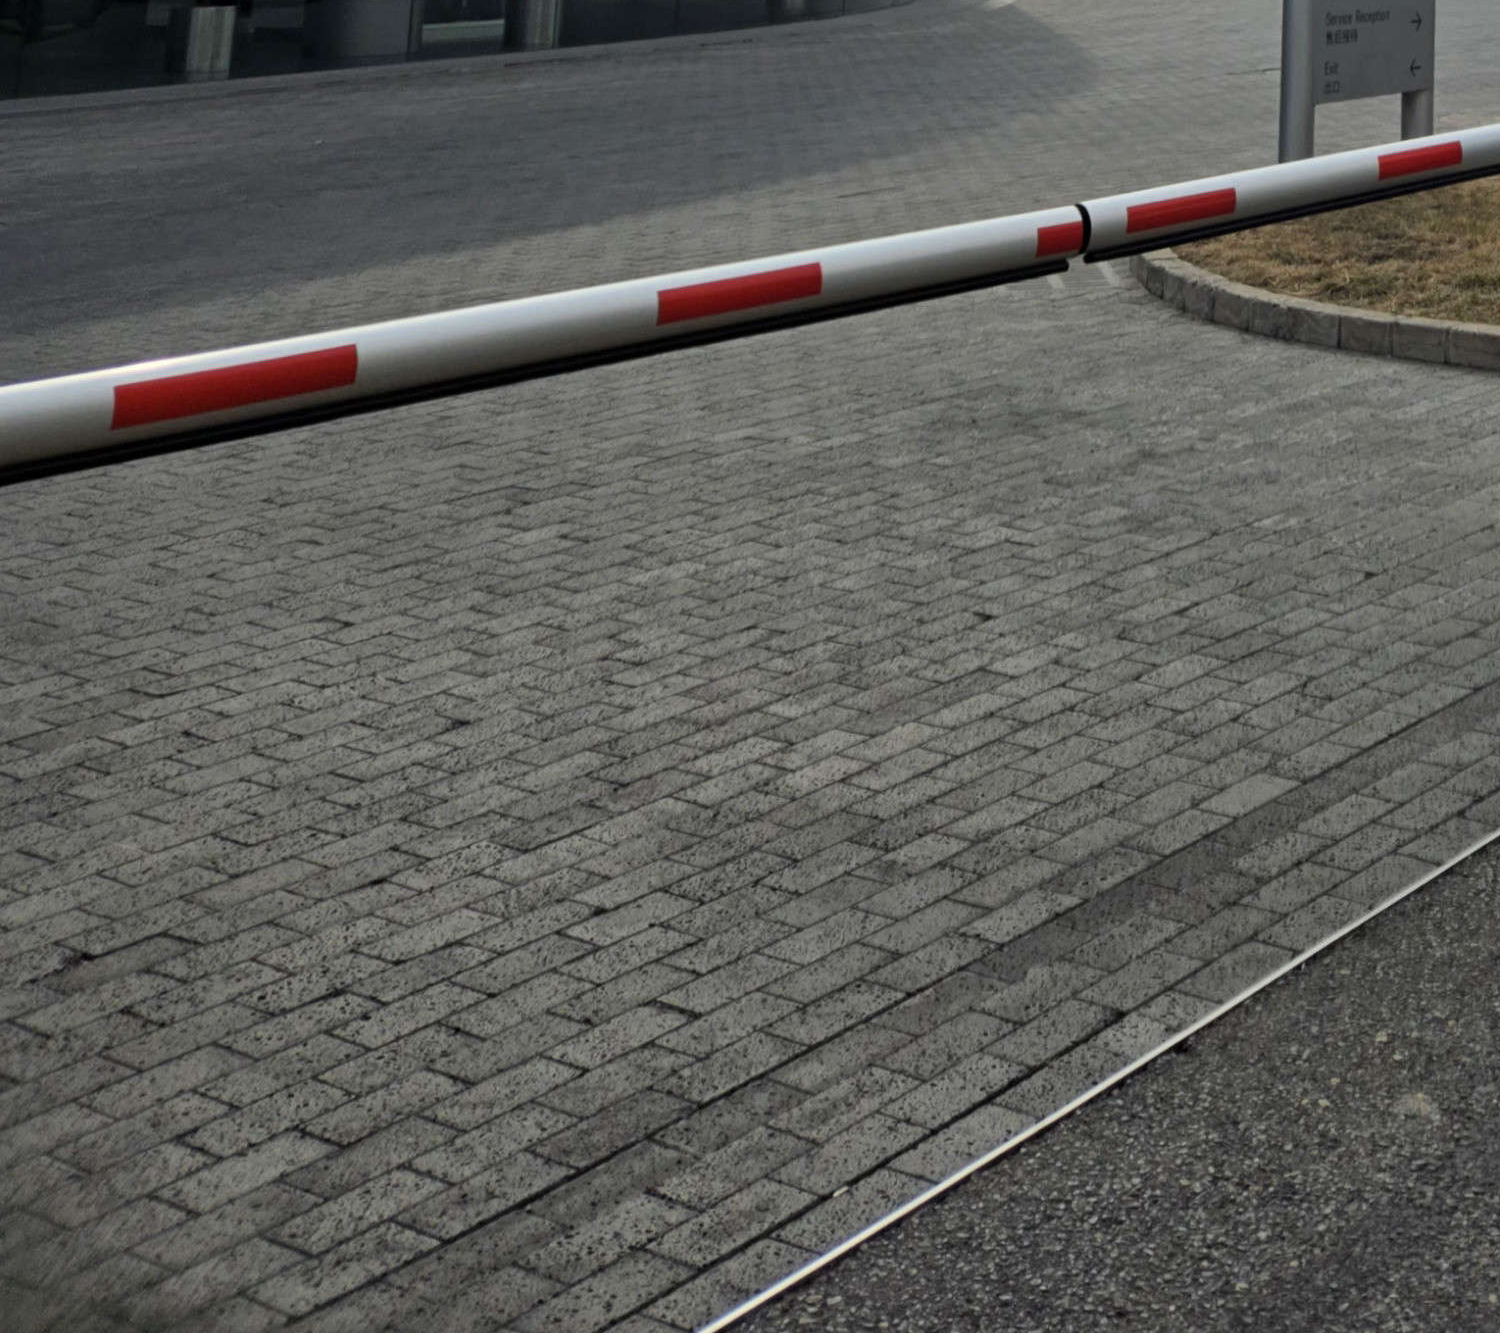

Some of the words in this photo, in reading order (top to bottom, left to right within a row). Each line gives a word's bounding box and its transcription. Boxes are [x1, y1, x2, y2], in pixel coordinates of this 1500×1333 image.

[1326, 12, 1352, 26] Service
[1355, 10, 1390, 25] Reception
[1324, 61, 1340, 76] Exit
